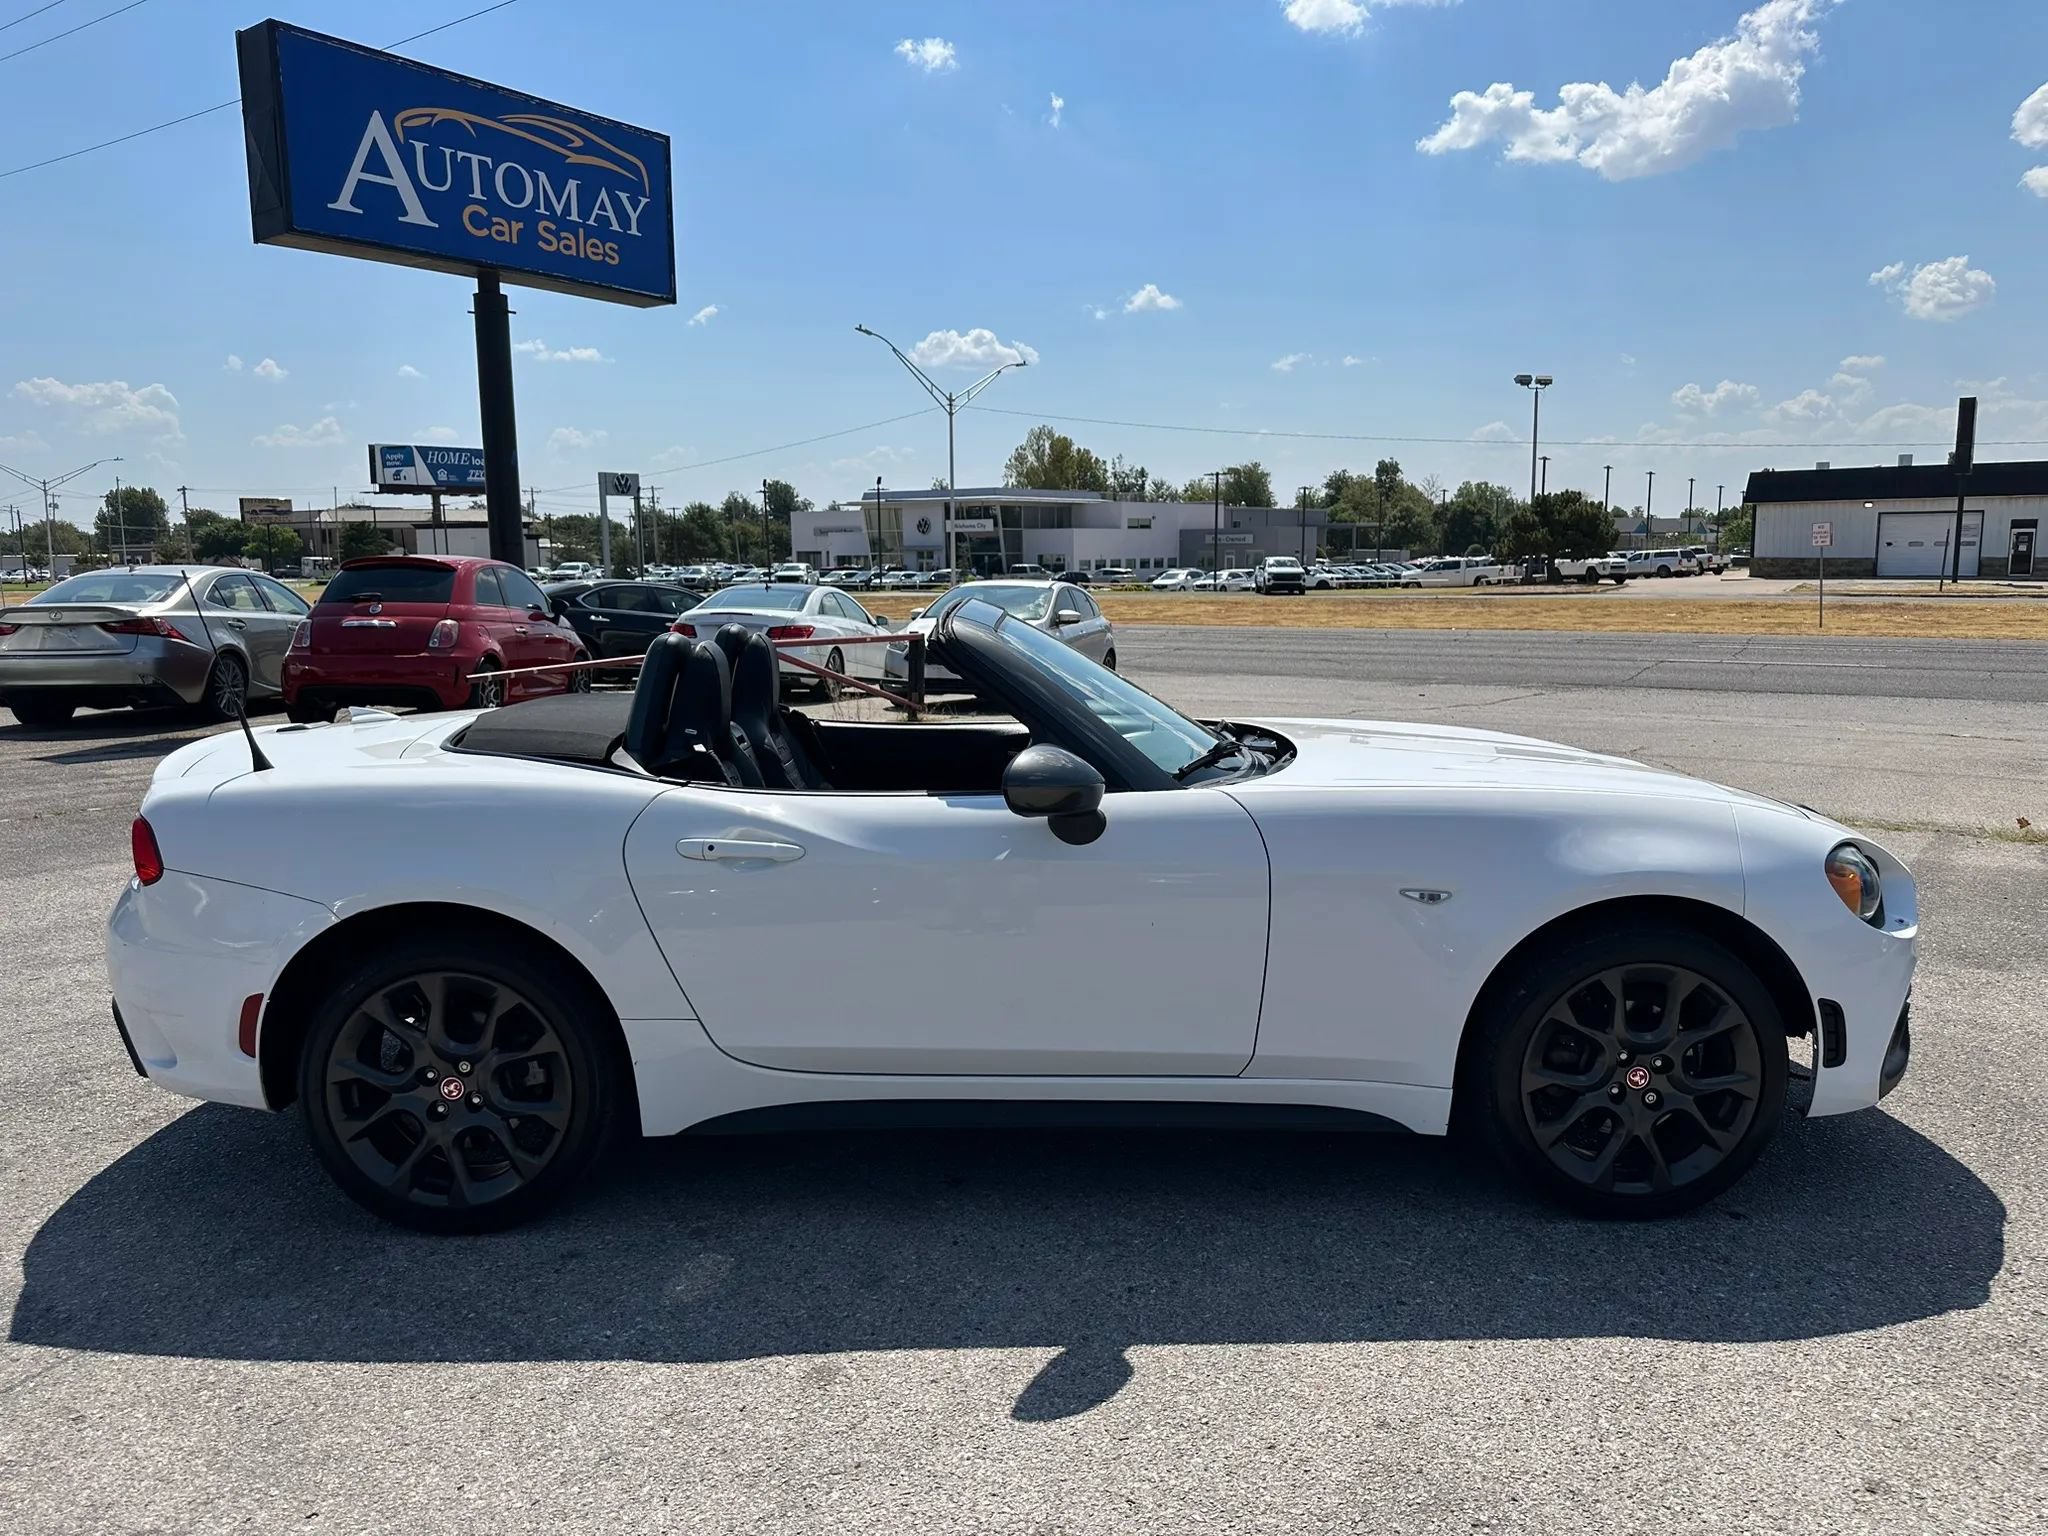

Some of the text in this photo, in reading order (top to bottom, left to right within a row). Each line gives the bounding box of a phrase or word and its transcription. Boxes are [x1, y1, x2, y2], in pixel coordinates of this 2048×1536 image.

[327, 109, 650, 237] AUTOMAY
[462, 204, 620, 266] Car Sales
[385, 453, 404, 461] Apply
[427, 451, 471, 465] HOME
